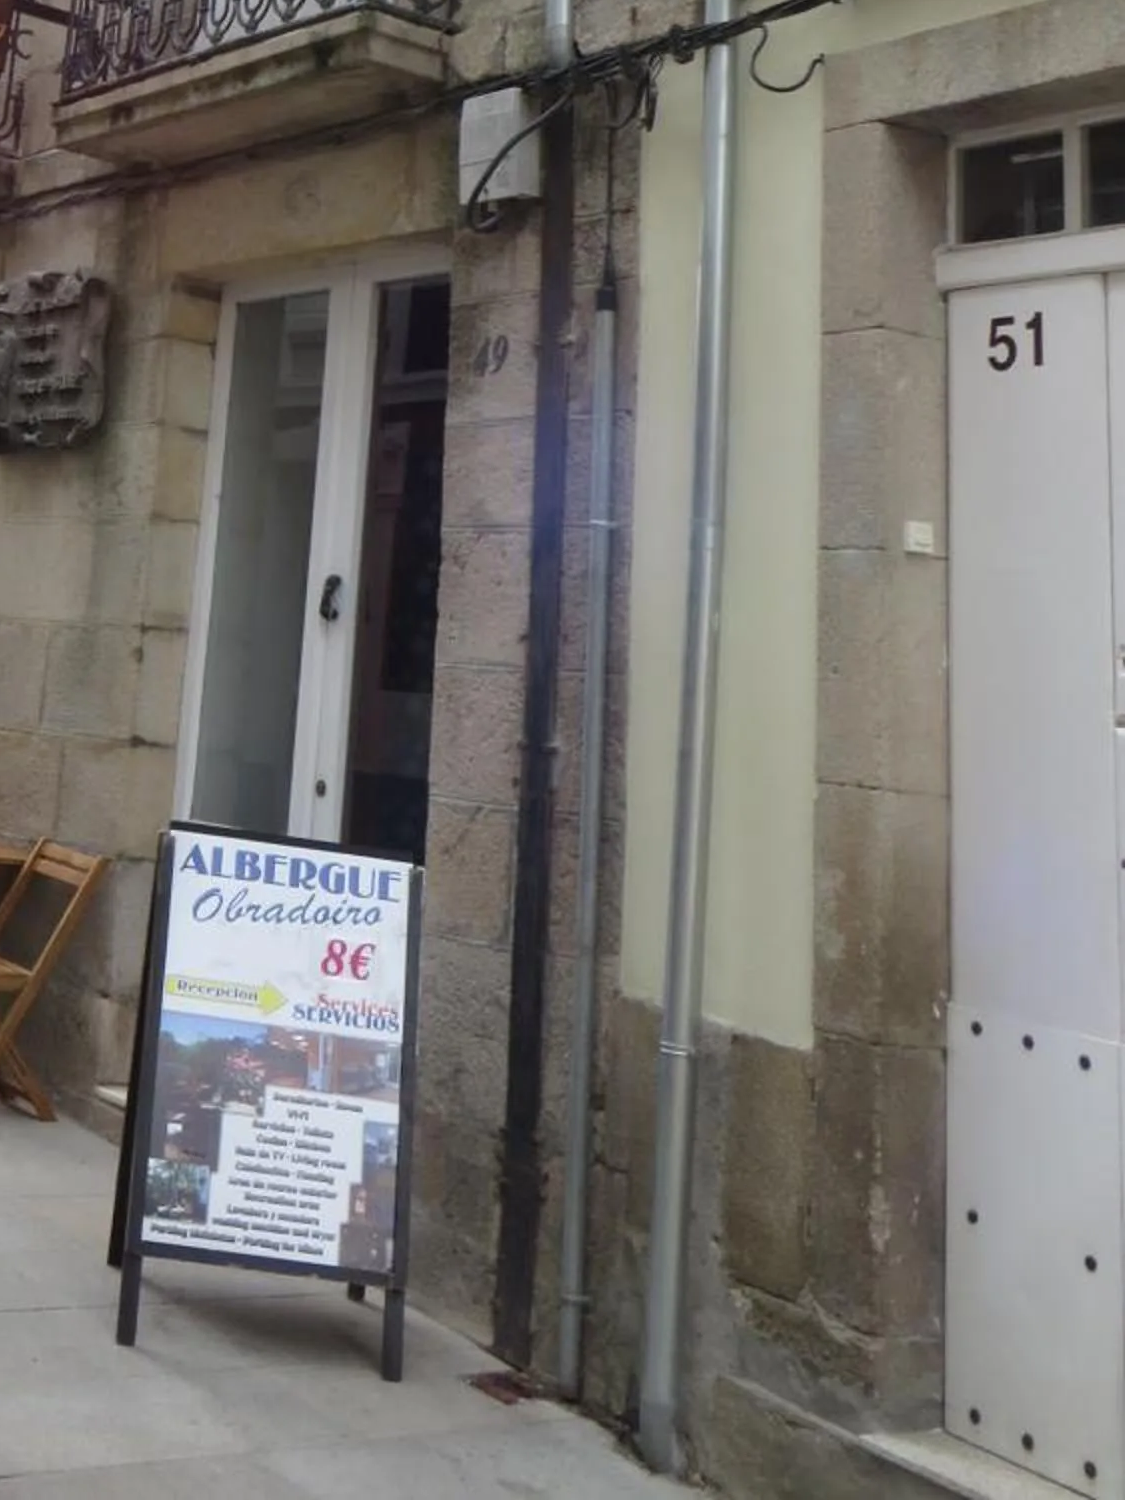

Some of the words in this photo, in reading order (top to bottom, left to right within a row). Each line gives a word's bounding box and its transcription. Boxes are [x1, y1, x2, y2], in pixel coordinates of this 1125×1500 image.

[473, 334, 509, 378] 49
[988, 311, 1043, 372] 51
[179, 843, 403, 903] ALBERGUE
[192, 888, 384, 926] Obradoiro
[320, 938, 376, 981] 8€
[291, 1003, 400, 1033] SERVICIOS
